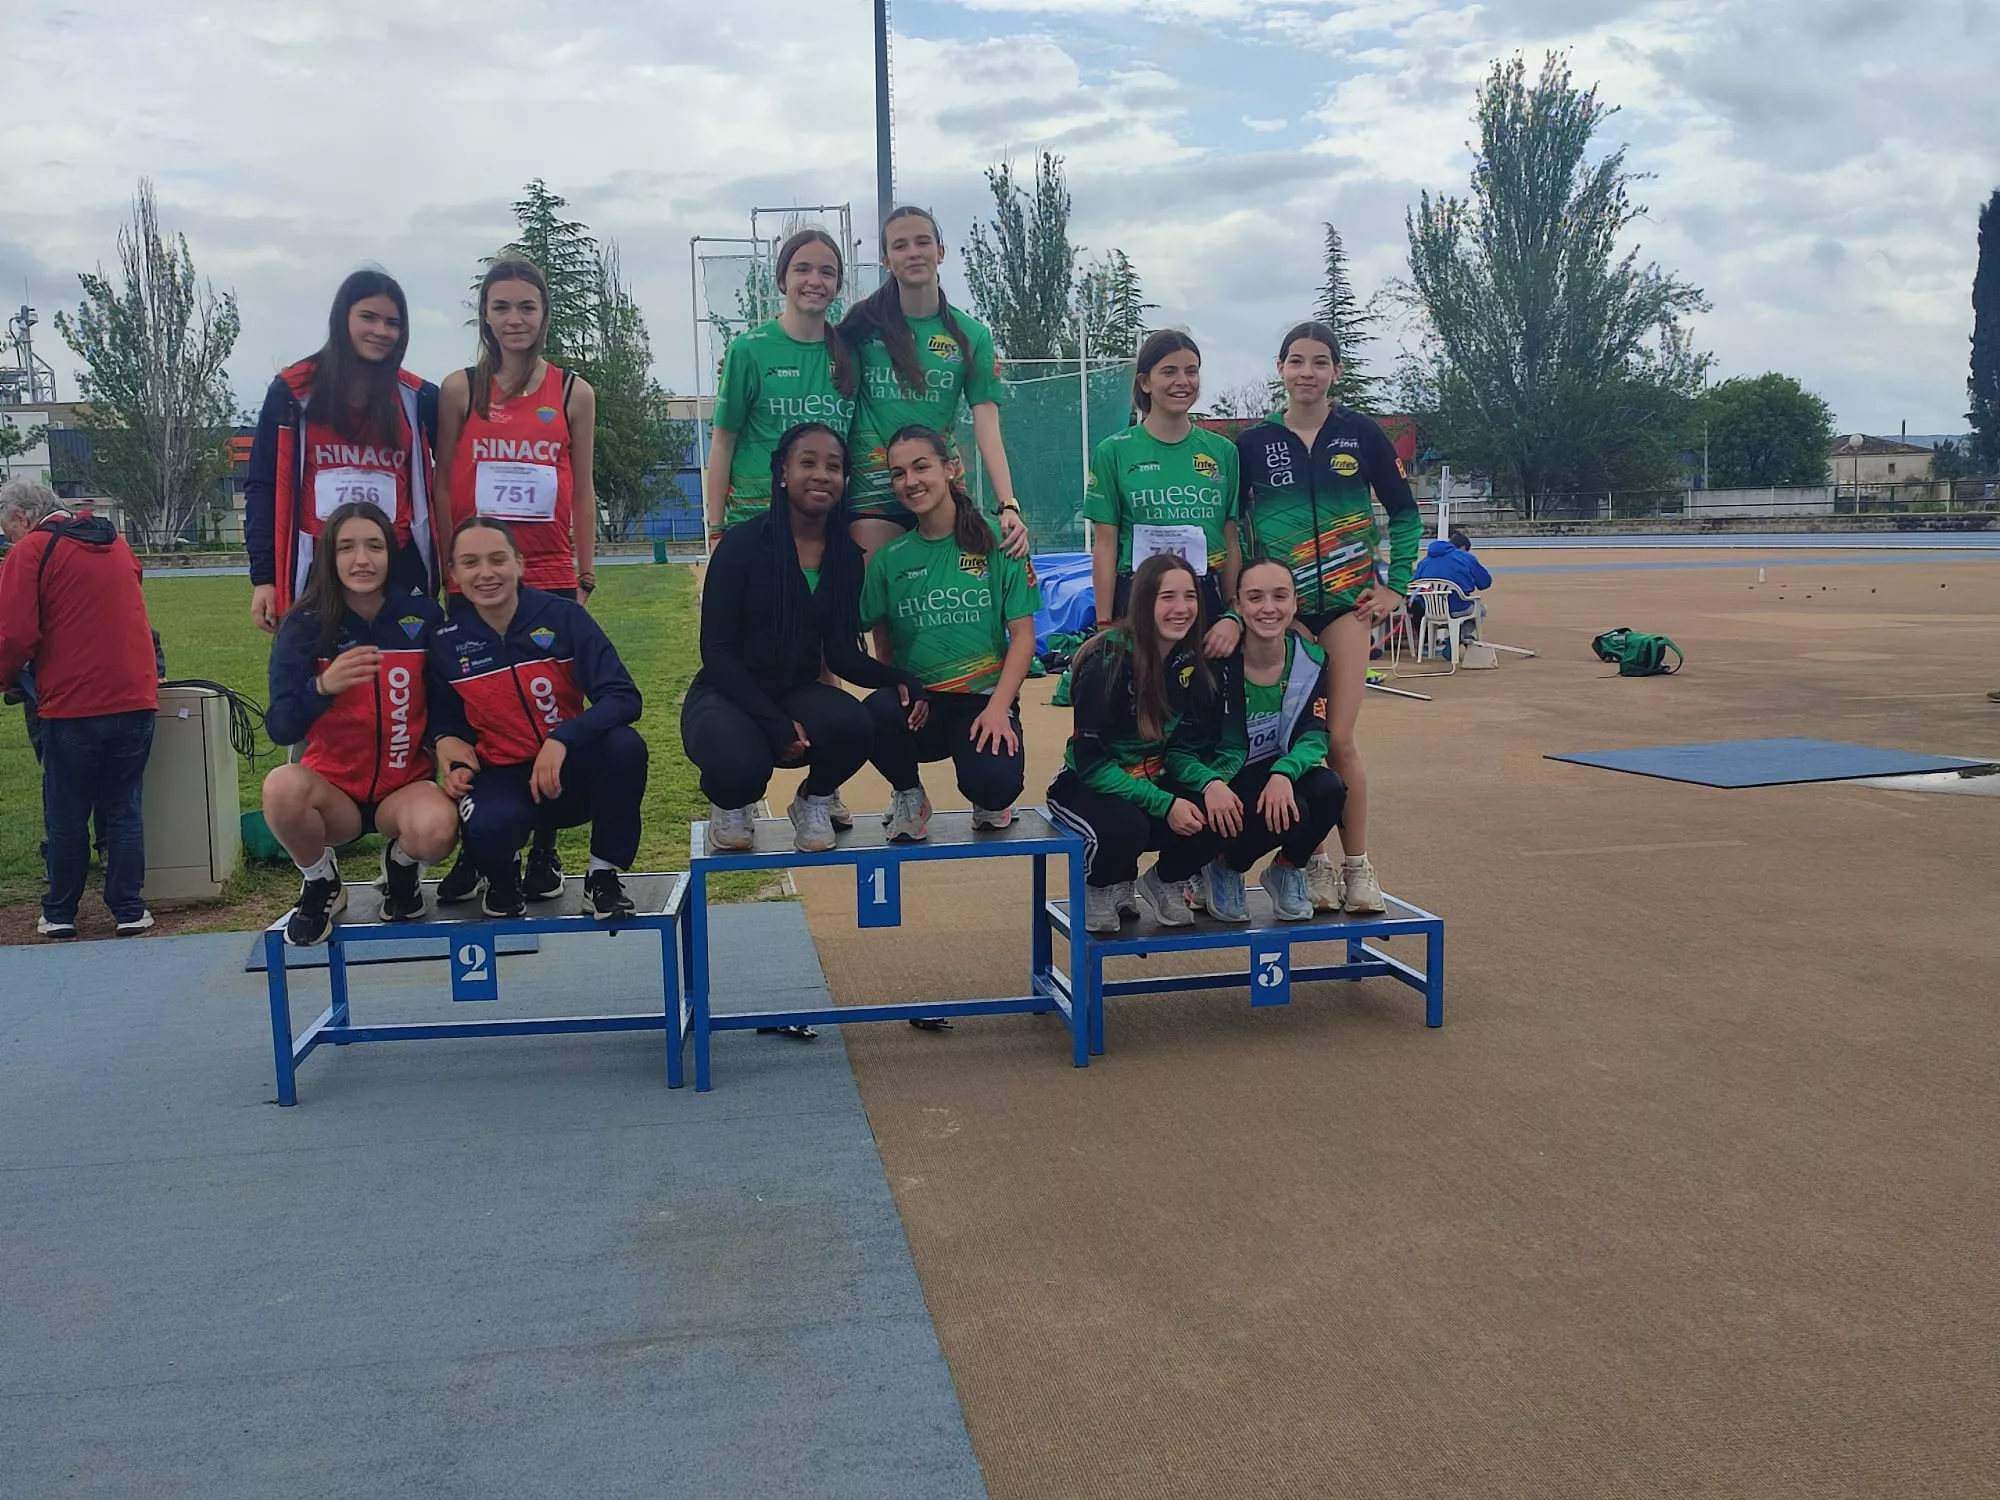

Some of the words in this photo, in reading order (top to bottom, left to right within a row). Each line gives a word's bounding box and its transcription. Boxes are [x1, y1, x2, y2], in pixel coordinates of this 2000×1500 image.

[315, 444, 406, 469] HINACO
[335, 486, 380, 503] 756
[493, 485, 535, 504] 751
[1130, 484, 1223, 508] Huesca
[388, 666, 411, 769] HINACO
[1250, 728, 1277, 747] 04
[867, 867, 888, 904] 1
[458, 944, 488, 982] 2
[1257, 952, 1284, 987] 3
